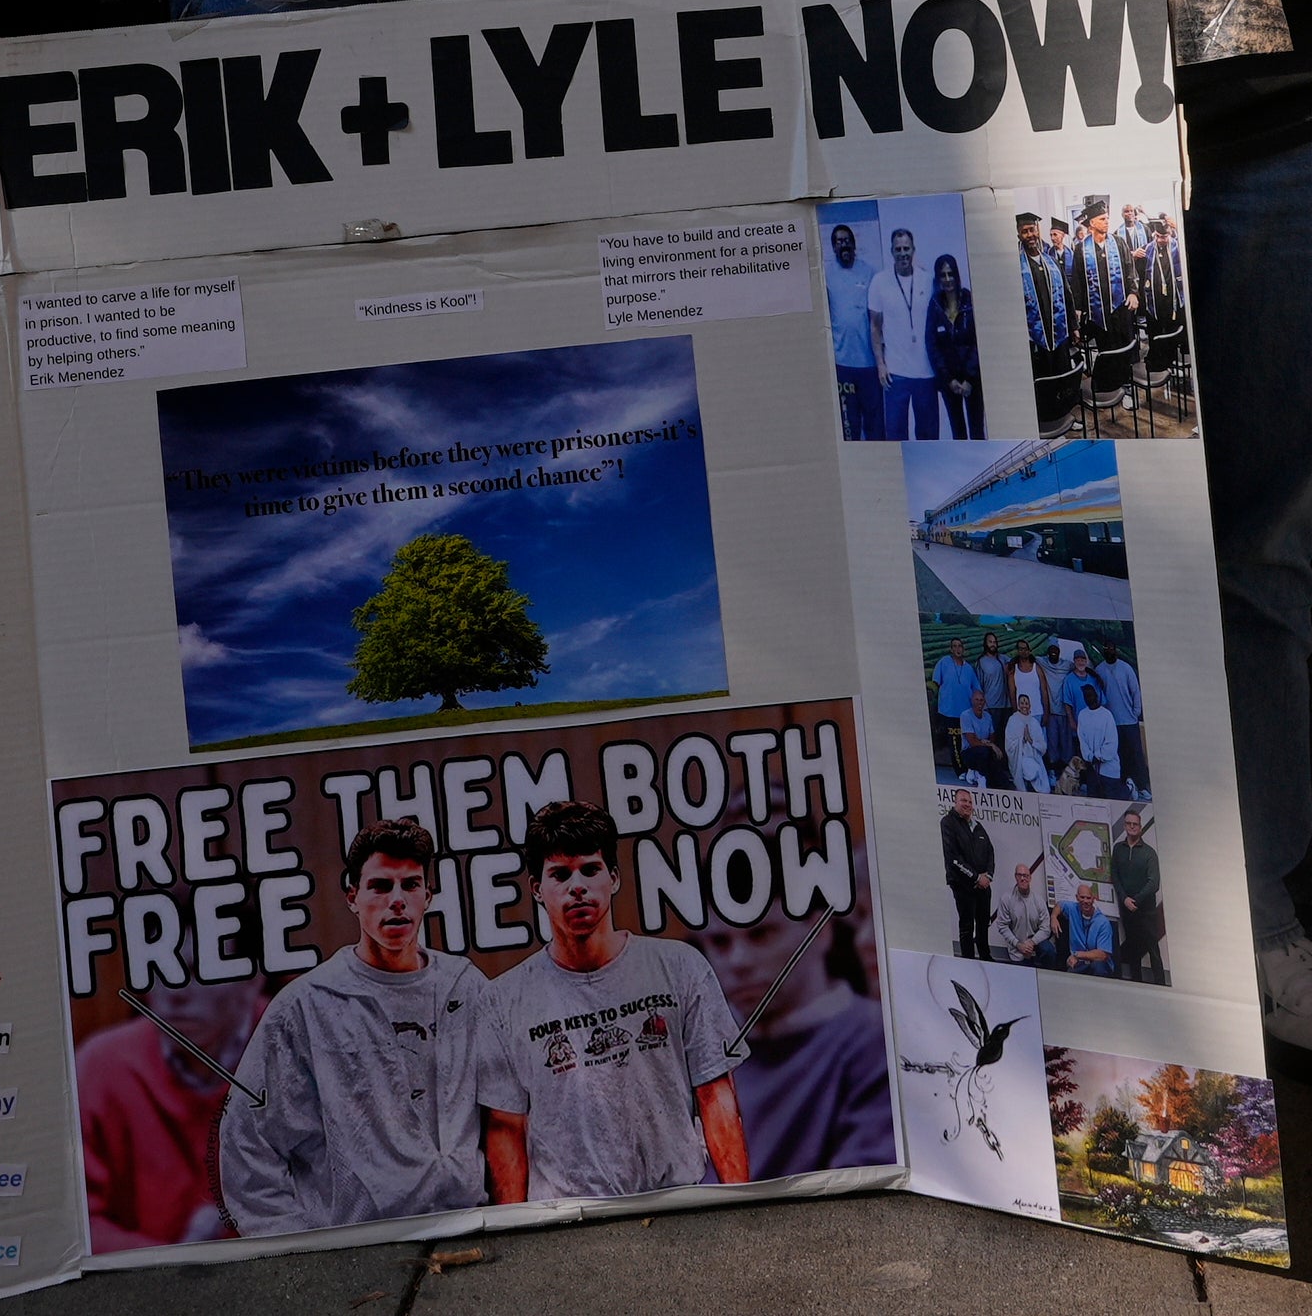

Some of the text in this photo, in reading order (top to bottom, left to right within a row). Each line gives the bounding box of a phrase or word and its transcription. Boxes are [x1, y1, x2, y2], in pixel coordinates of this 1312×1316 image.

[340, 76, 409, 166] +
[431, 5, 773, 168] LYLE
[633, 234, 664, 247] have
[668, 232, 680, 244] to
[683, 229, 713, 243] build
[717, 227, 740, 240] and
[744, 224, 784, 237] create
[788, 223, 796, 233] a
[602, 241, 803, 269] living environment for a prisoner
[604, 260, 790, 287] that mirrors their rehabilitative
[36, 295, 82, 311] wanted
[86, 294, 98, 305] to
[102, 291, 136, 304] carve
[140, 290, 148, 300] a
[152, 286, 170, 299] life
[174, 284, 190, 297] for
[194, 280, 235, 297] myself
[426, 298, 437, 310] is
[25, 304, 175, 332] in prison. I wanted to be
[608, 305, 703, 325] Lyle Menendez
[27, 319, 235, 351] productive, to find some meaning
[28, 355, 42, 370] by
[47, 350, 93, 367] helping
[30, 366, 125, 386] Erik Menendez
[237, 465, 288, 485] were
[291, 455, 370, 479] victims
[372, 446, 443, 472] before
[448, 441, 494, 467] they
[494, 440, 547, 459] were
[244, 495, 294, 518] time
[298, 493, 320, 512] to
[323, 487, 367, 516] give
[372, 482, 427, 504] them
[432, 484, 444, 498] a
[448, 469, 523, 496] second
[55, 720, 849, 896] FREE THEM BOTH
[62, 870, 323, 999] FREE
[634, 815, 857, 935] NOW
[529, 994, 678, 1042] FOUR KEYS TO SUCCESS.
